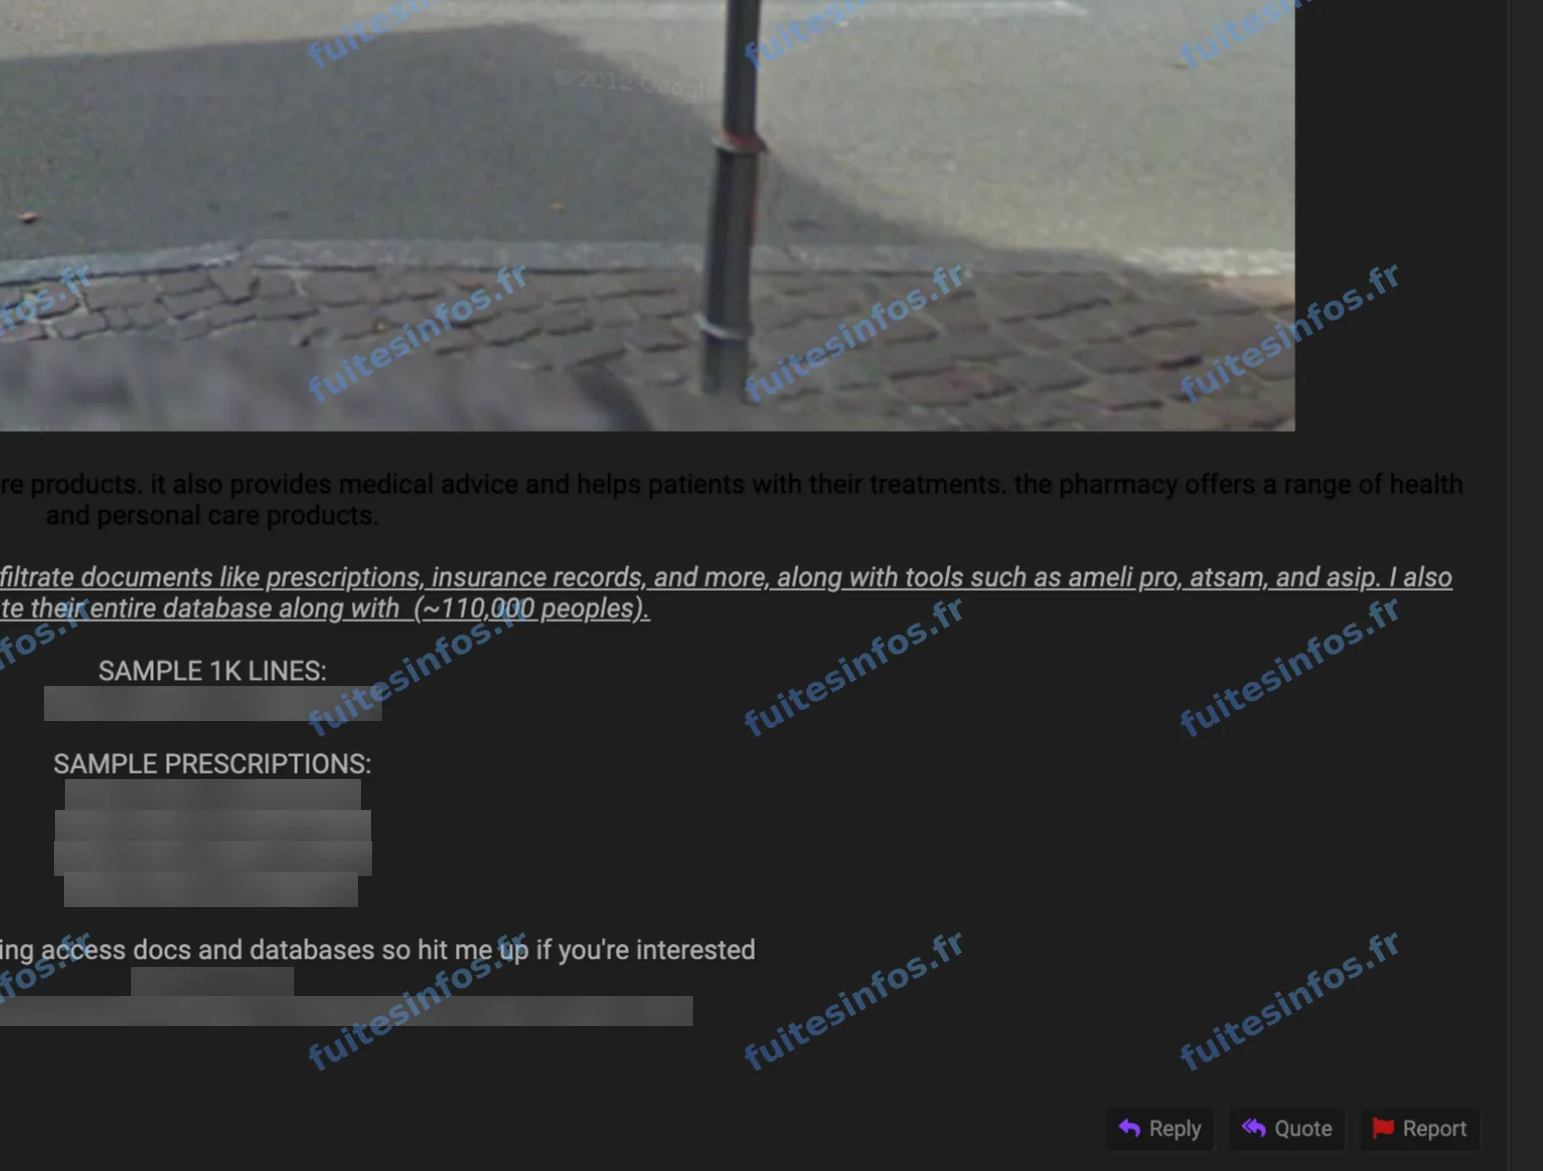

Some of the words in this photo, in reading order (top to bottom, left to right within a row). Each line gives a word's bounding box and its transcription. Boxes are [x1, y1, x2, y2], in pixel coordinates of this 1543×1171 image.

[30, 471, 144, 501] products.
[150, 472, 167, 496] it
[171, 471, 224, 496] also
[229, 471, 333, 501] provides
[338, 471, 435, 496] medical
[440, 471, 520, 496] advice
[524, 471, 571, 496] and
[576, 471, 643, 501] helps
[647, 472, 747, 501] patients
[750, 471, 803, 496] with
[807, 471, 865, 496] their
[867, 473, 1008, 496] treatments.
[1012, 471, 1054, 496] the
[1058, 471, 1180, 501] pharmacy
[1184, 470, 1257, 496] offers
[1262, 476, 1278, 496] a
[1283, 476, 1353, 501] range
[1357, 470, 1385, 496] of
[1389, 470, 1465, 496] health
[45, 502, 91, 527] and
[96, 502, 202, 532] personal
[206, 507, 261, 527] care
[266, 502, 380, 532] products.
[80, 564, 214, 590] documents
[218, 564, 261, 590] like
[265, 565, 425, 594] prescriptions,
[431, 565, 548, 590] insurance
[552, 564, 647, 590] records,
[653, 564, 700, 590] and
[703, 569, 771, 590] more,
[776, 564, 844, 594] along
[849, 564, 899, 590] with
[904, 564, 965, 590] tools
[969, 564, 1028, 590] such
[1032, 569, 1063, 590] as
[1067, 564, 1135, 590] ameli
[1138, 569, 1183, 594] pro,
[1189, 566, 1269, 590] atsam,
[1275, 564, 1322, 590] and
[1325, 565, 1381, 594] asip.
[1388, 565, 1398, 590] I
[1402, 564, 1454, 590] also
[30, 595, 86, 621] their
[89, 596, 158, 621] entire
[162, 595, 273, 621] database
[277, 595, 345, 625] along
[350, 595, 401, 621] with
[413, 594, 536, 625] (~110,000
[540, 594, 649, 625] peoples).
[98, 658, 204, 682] SAMPLE
[209, 659, 243, 682] 1K
[248, 658, 327, 682] LINES:
[52, 751, 159, 775] SAMPLE
[164, 751, 372, 775] PRESCRIPTIONS:
[40, 942, 127, 961] access
[132, 936, 192, 961] docs
[197, 936, 243, 961] and
[249, 936, 376, 961] databases
[381, 942, 412, 961] so
[417, 936, 449, 961] hit
[454, 942, 494, 961] me
[499, 942, 530, 967] up
[536, 936, 554, 961] if
[557, 936, 630, 967] you're
[636, 936, 756, 961] interested
[1149, 1118, 1203, 1143] Reply
[1274, 1118, 1334, 1140] Quote
[1403, 1118, 1468, 1142] Report
